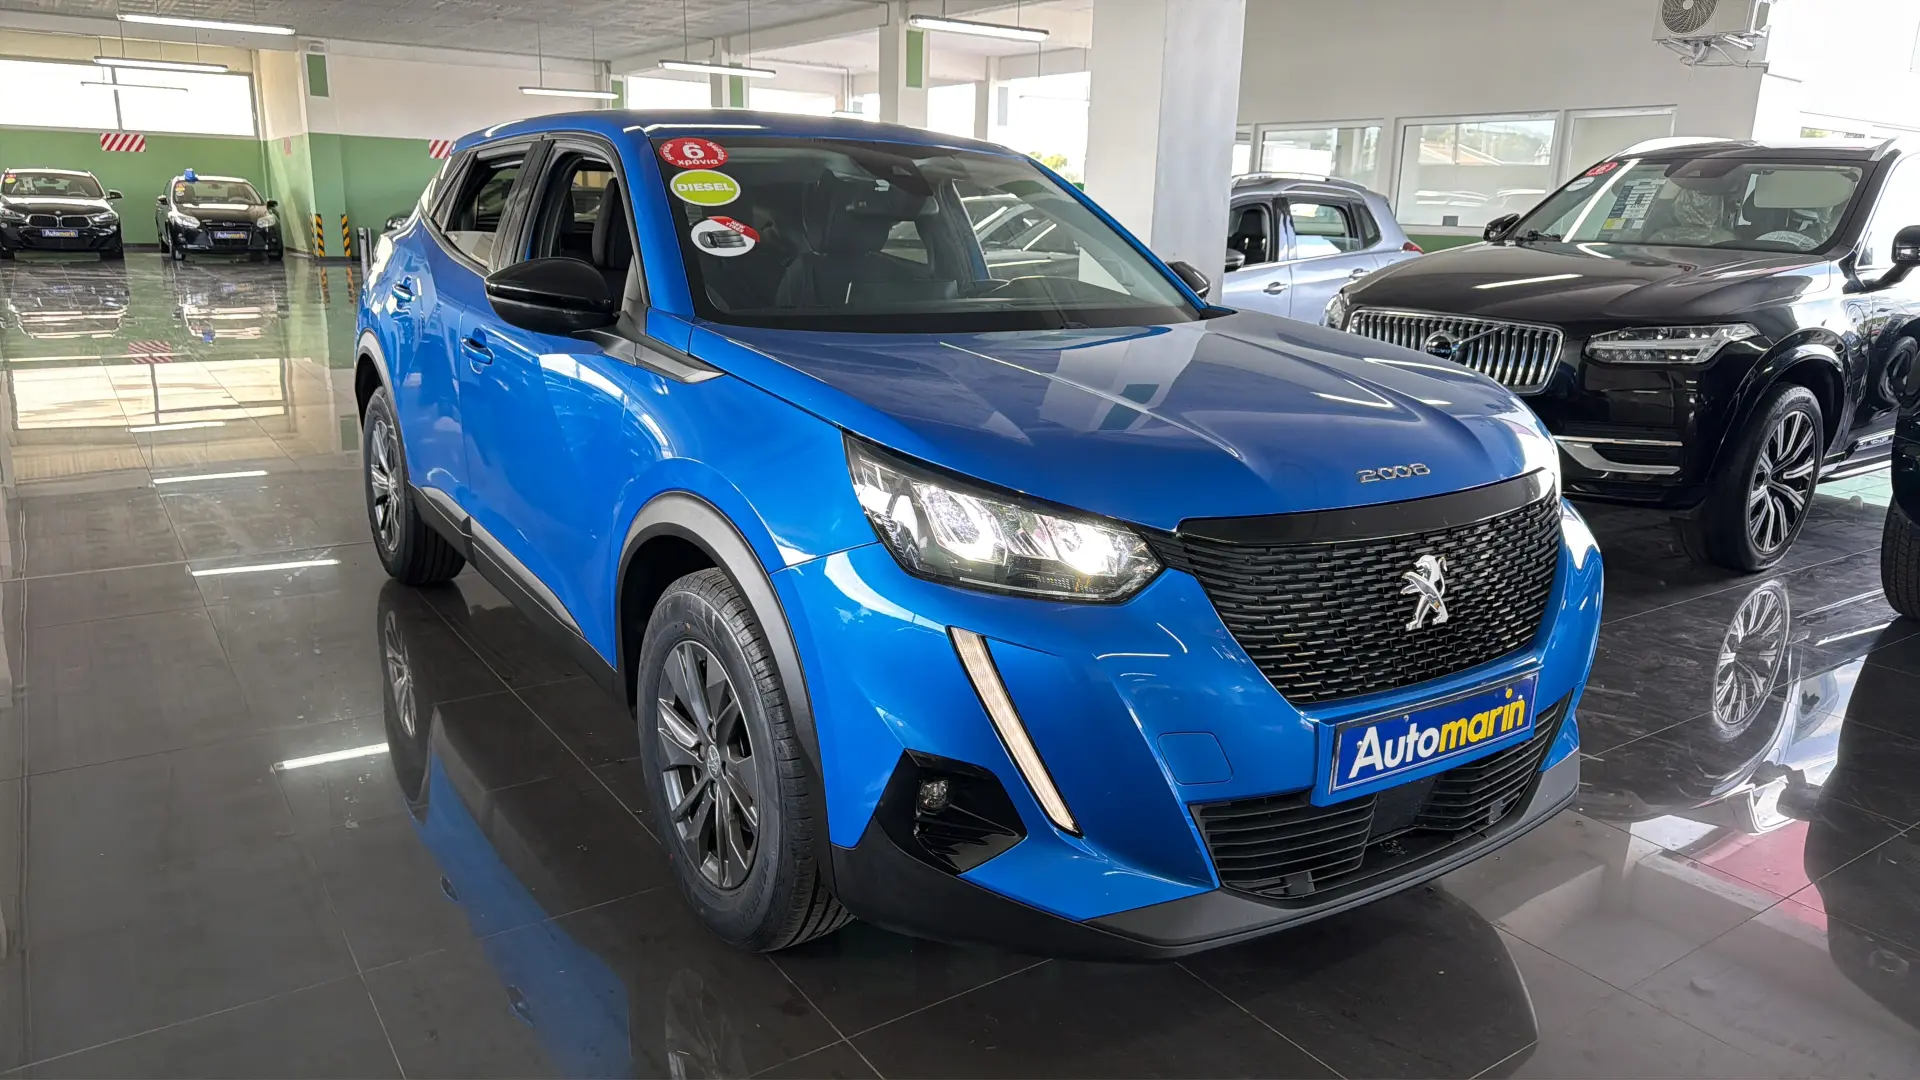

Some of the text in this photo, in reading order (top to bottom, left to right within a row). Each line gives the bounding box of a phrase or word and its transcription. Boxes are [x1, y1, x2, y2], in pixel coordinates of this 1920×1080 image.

[682, 144, 705, 159] 6
[677, 158, 719, 166] χρόνια
[676, 183, 734, 192] DIESEL
[1356, 462, 1431, 484] 2008
[1348, 688, 1526, 779] Automarin
